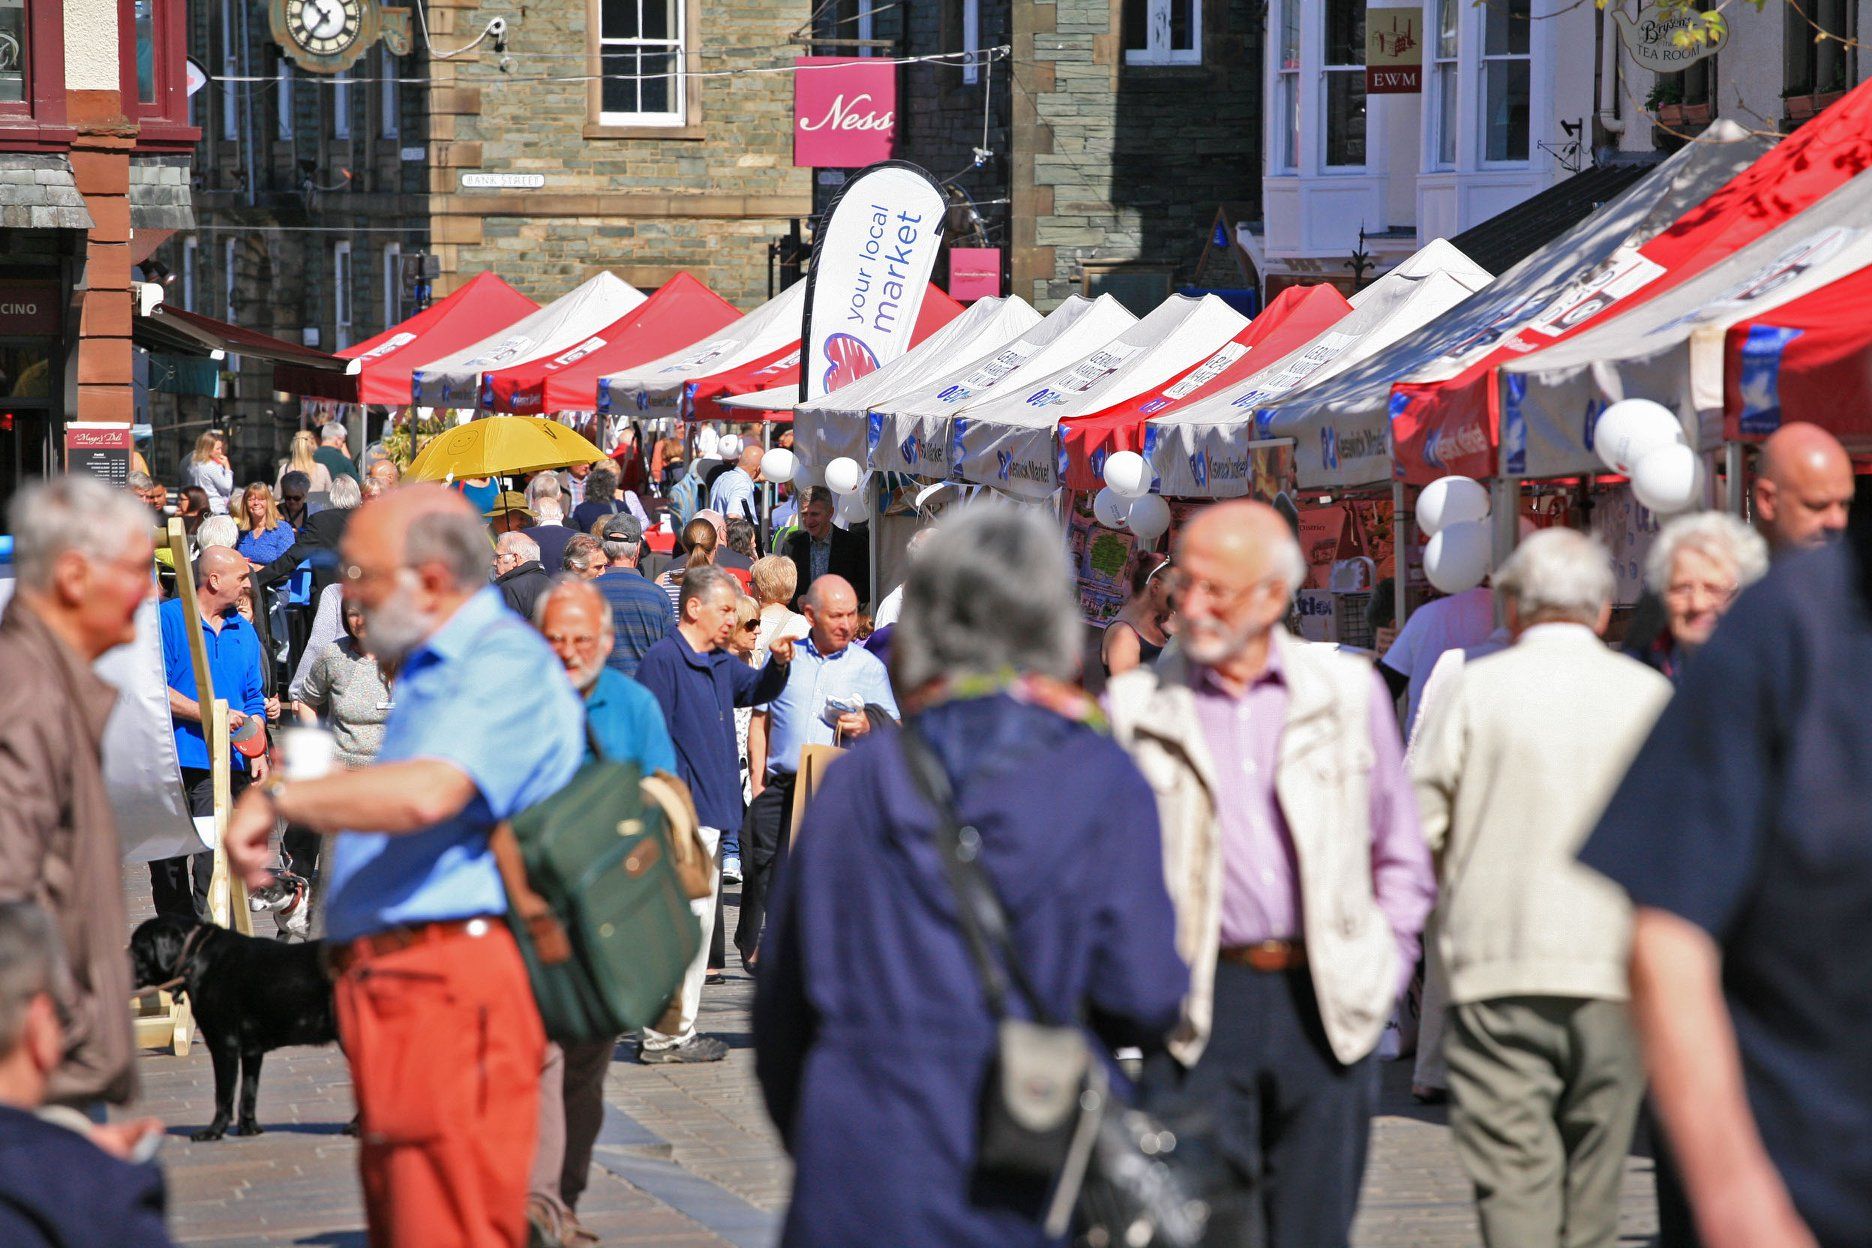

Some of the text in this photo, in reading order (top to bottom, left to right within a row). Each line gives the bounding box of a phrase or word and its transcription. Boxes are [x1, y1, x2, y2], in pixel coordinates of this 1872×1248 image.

[1636, 44, 1700, 61] TEA ROOM
[1374, 72, 1416, 87] EWM
[799, 93, 895, 131] Ness
[847, 204, 890, 325] your local
[872, 210, 923, 335] market
[1029, 456, 1050, 483] Market
